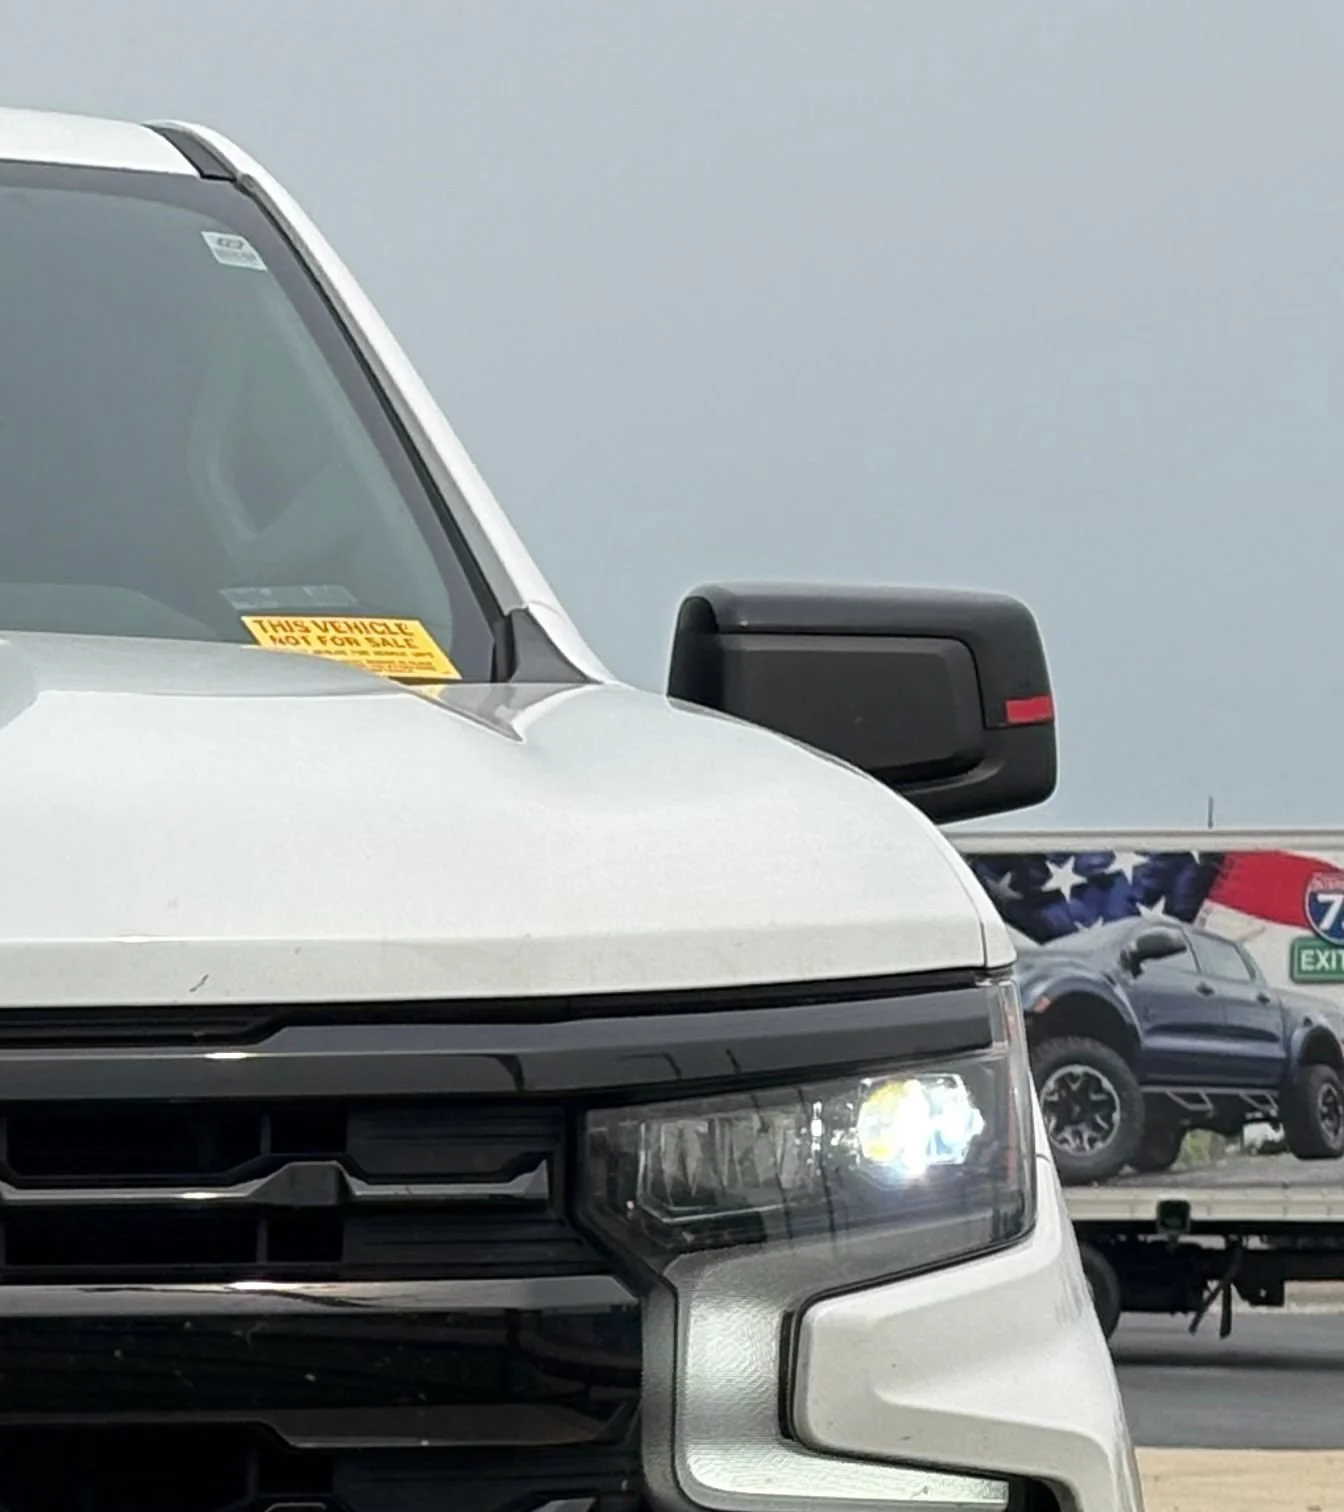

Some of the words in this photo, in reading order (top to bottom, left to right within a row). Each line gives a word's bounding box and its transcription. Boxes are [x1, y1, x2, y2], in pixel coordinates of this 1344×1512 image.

[252, 619, 312, 634] THIS
[310, 620, 414, 637] VEHICLE
[268, 634, 312, 647] NOT
[316, 635, 361, 648] FOR
[364, 636, 418, 650] SALE
[1317, 893, 1344, 930] 7
